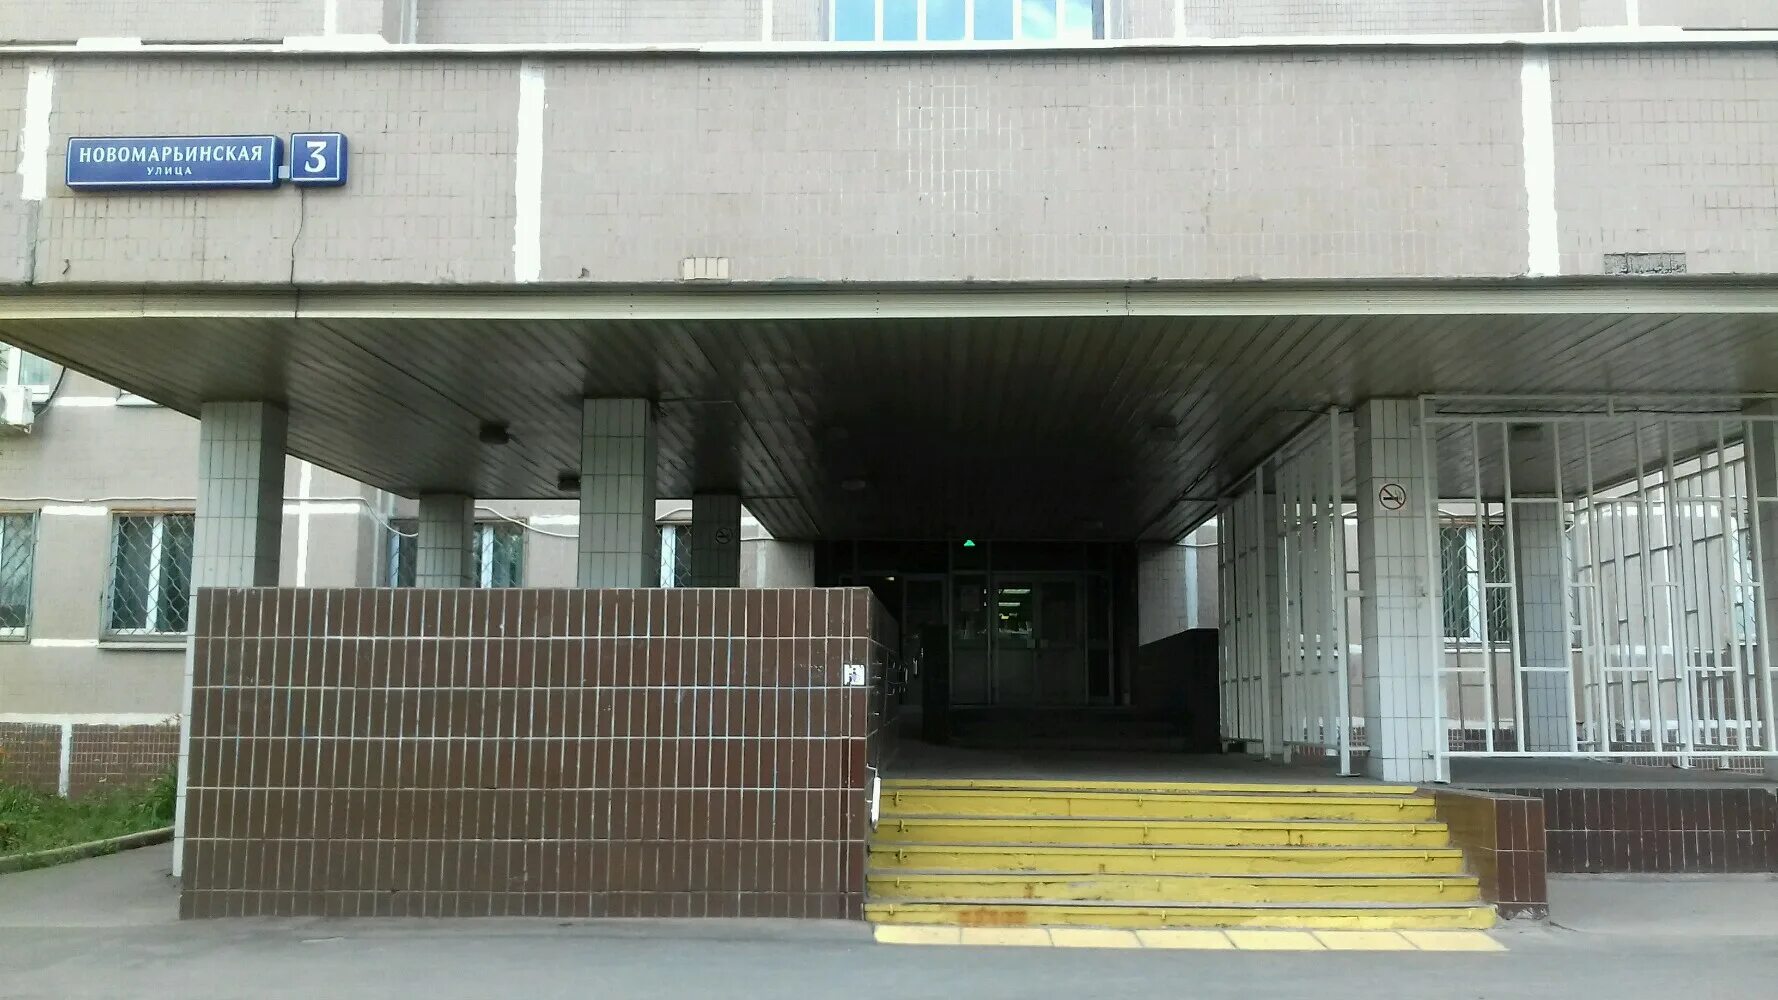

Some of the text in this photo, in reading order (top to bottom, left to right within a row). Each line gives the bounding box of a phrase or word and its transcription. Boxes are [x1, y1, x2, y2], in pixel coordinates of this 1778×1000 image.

[79, 145, 263, 163] НОВОМАРЬИНСКАЯ
[304, 140, 327, 173] 3
[147, 166, 193, 176] УЛИЦА
